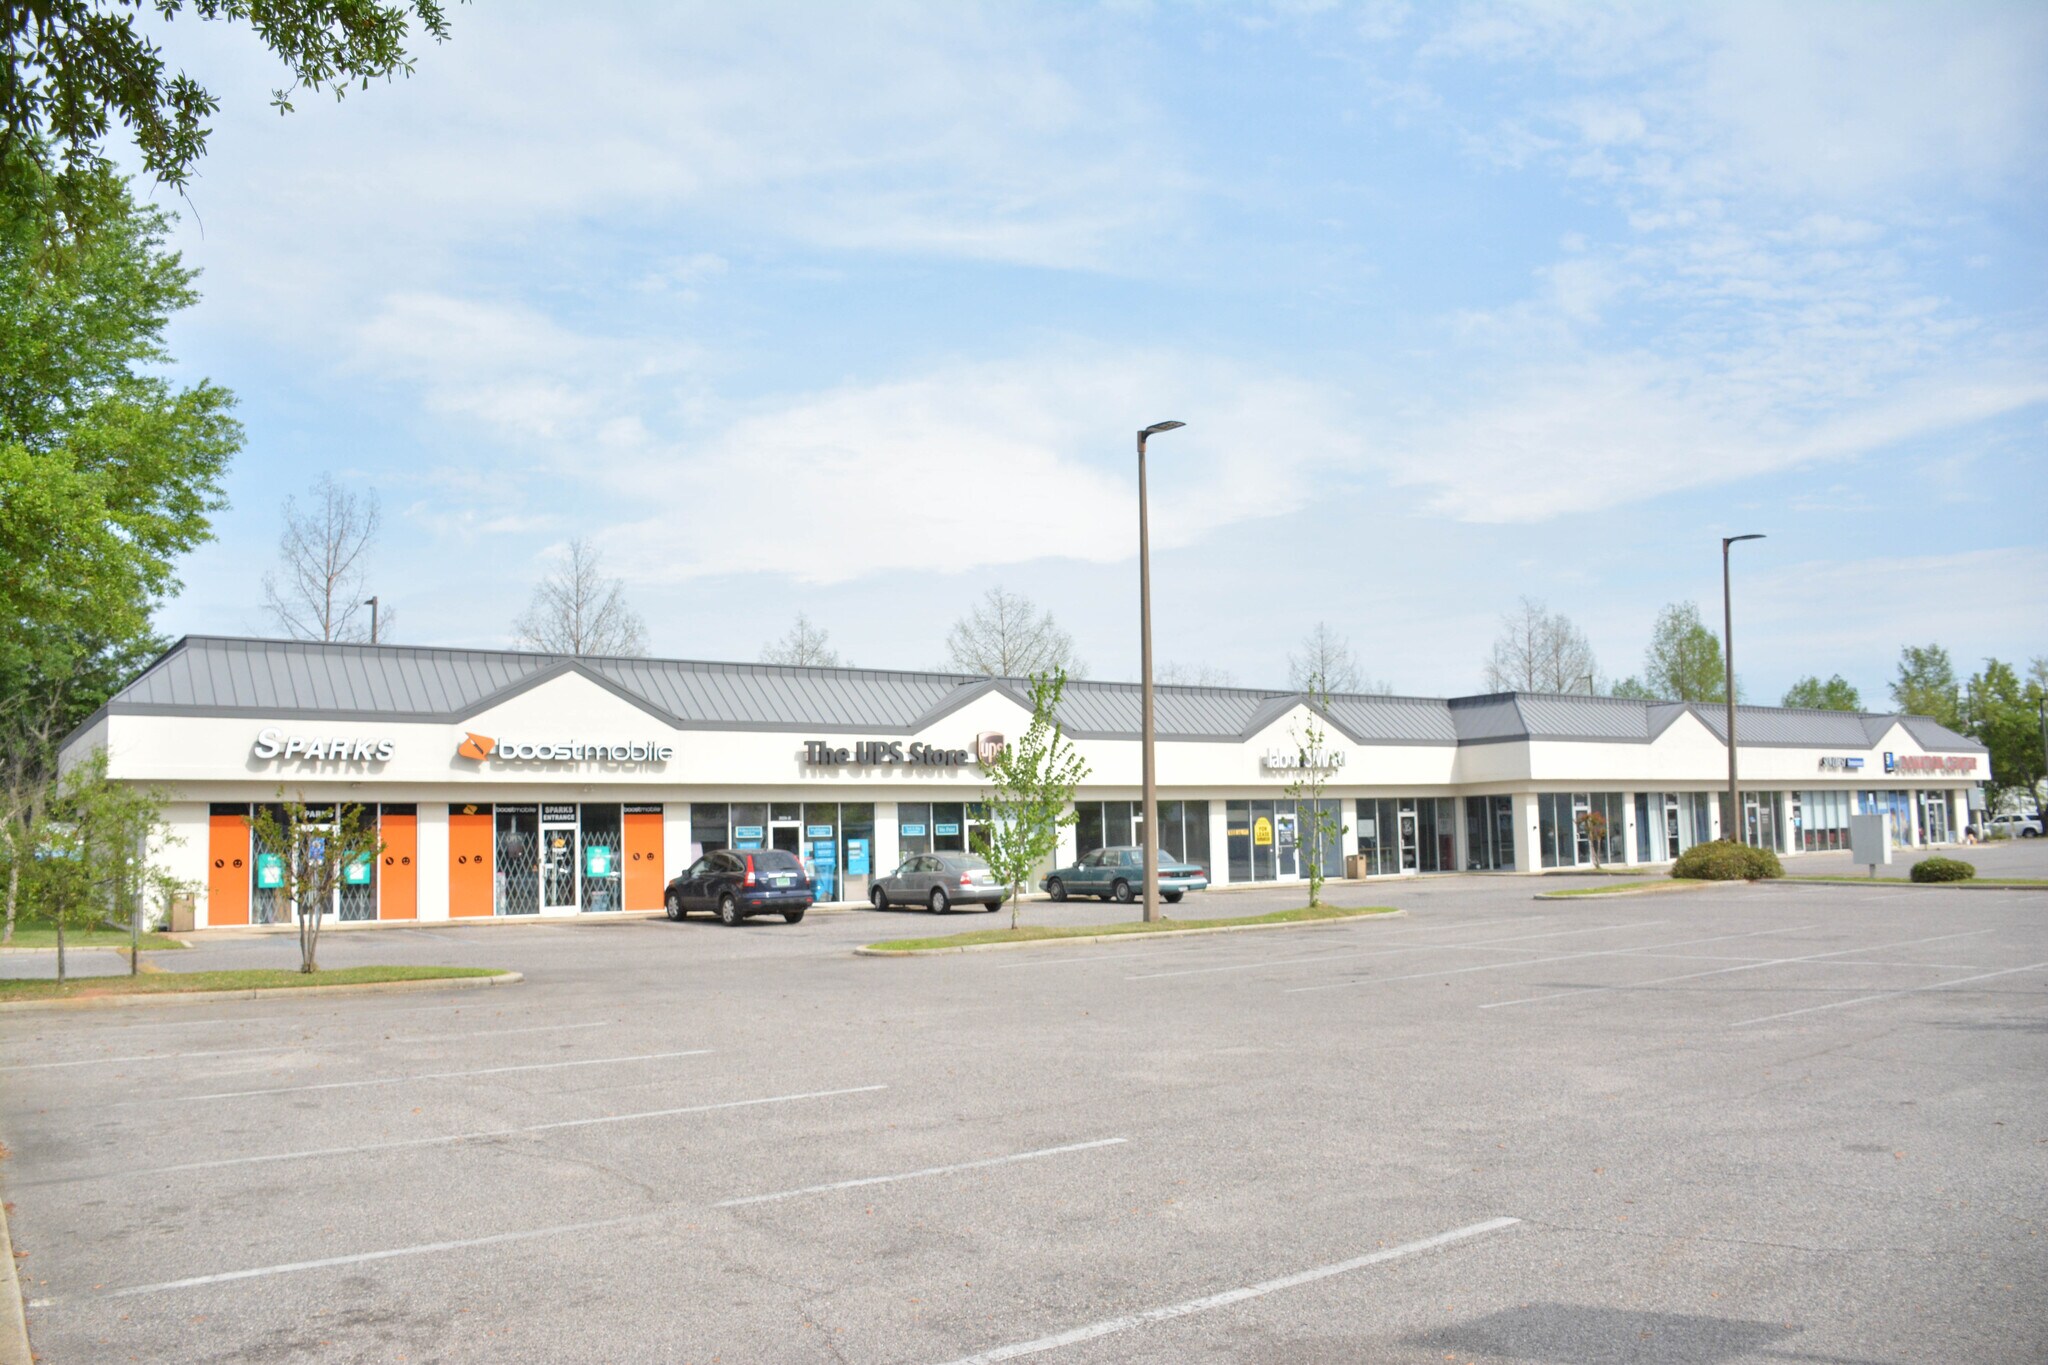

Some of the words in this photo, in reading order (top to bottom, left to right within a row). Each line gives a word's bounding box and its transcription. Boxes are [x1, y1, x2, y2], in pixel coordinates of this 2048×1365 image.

[254, 727, 395, 761] SPARKS
[804, 740, 850, 766] The
[856, 740, 903, 766] UPS
[909, 741, 969, 766] Store
[545, 806, 574, 814] SPARKS
